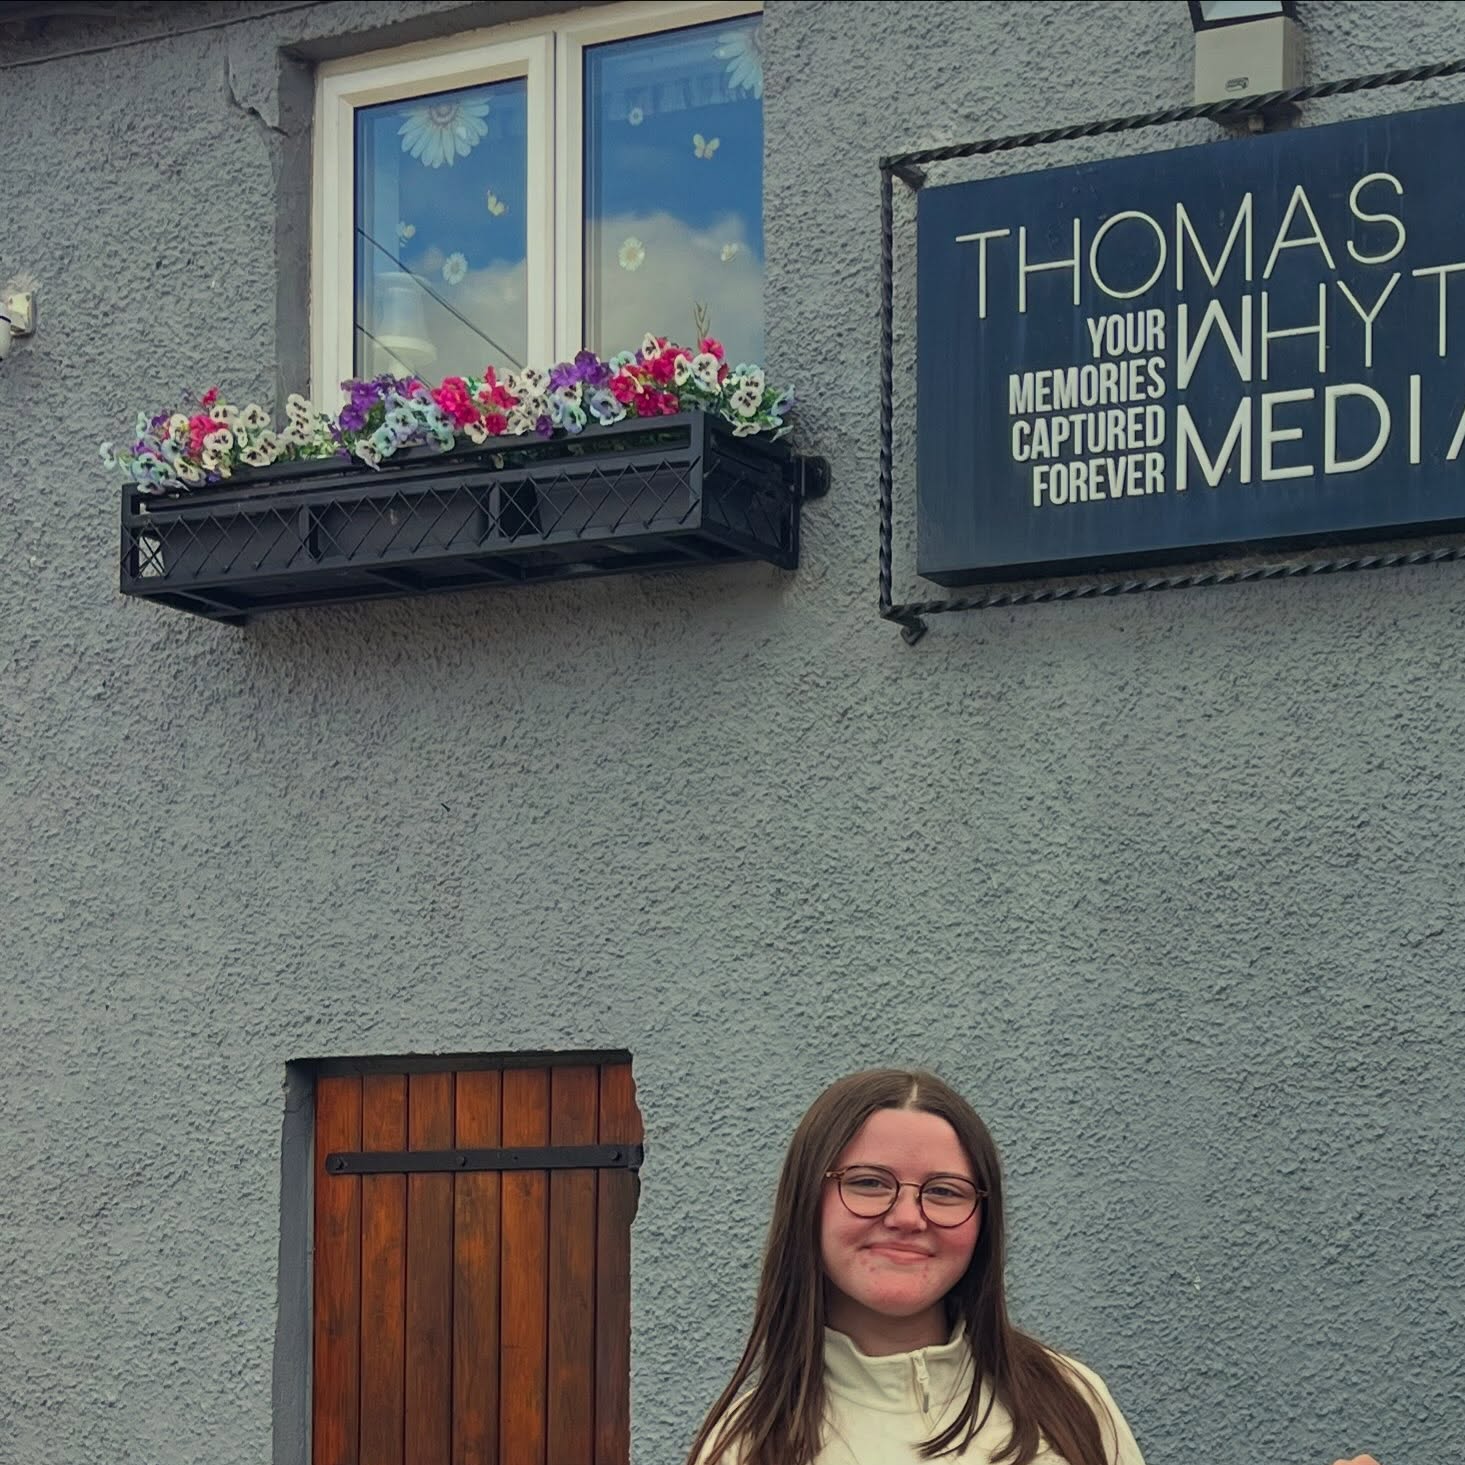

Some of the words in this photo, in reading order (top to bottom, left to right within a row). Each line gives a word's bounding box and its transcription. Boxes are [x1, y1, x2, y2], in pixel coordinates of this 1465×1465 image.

[955, 172, 1406, 319] THOMAS
[1087, 309, 1166, 358] YOUR
[1008, 358, 1166, 415] MEMORIES
[1011, 404, 1166, 462] CAPTURED
[1032, 451, 1166, 507] FOREVER
